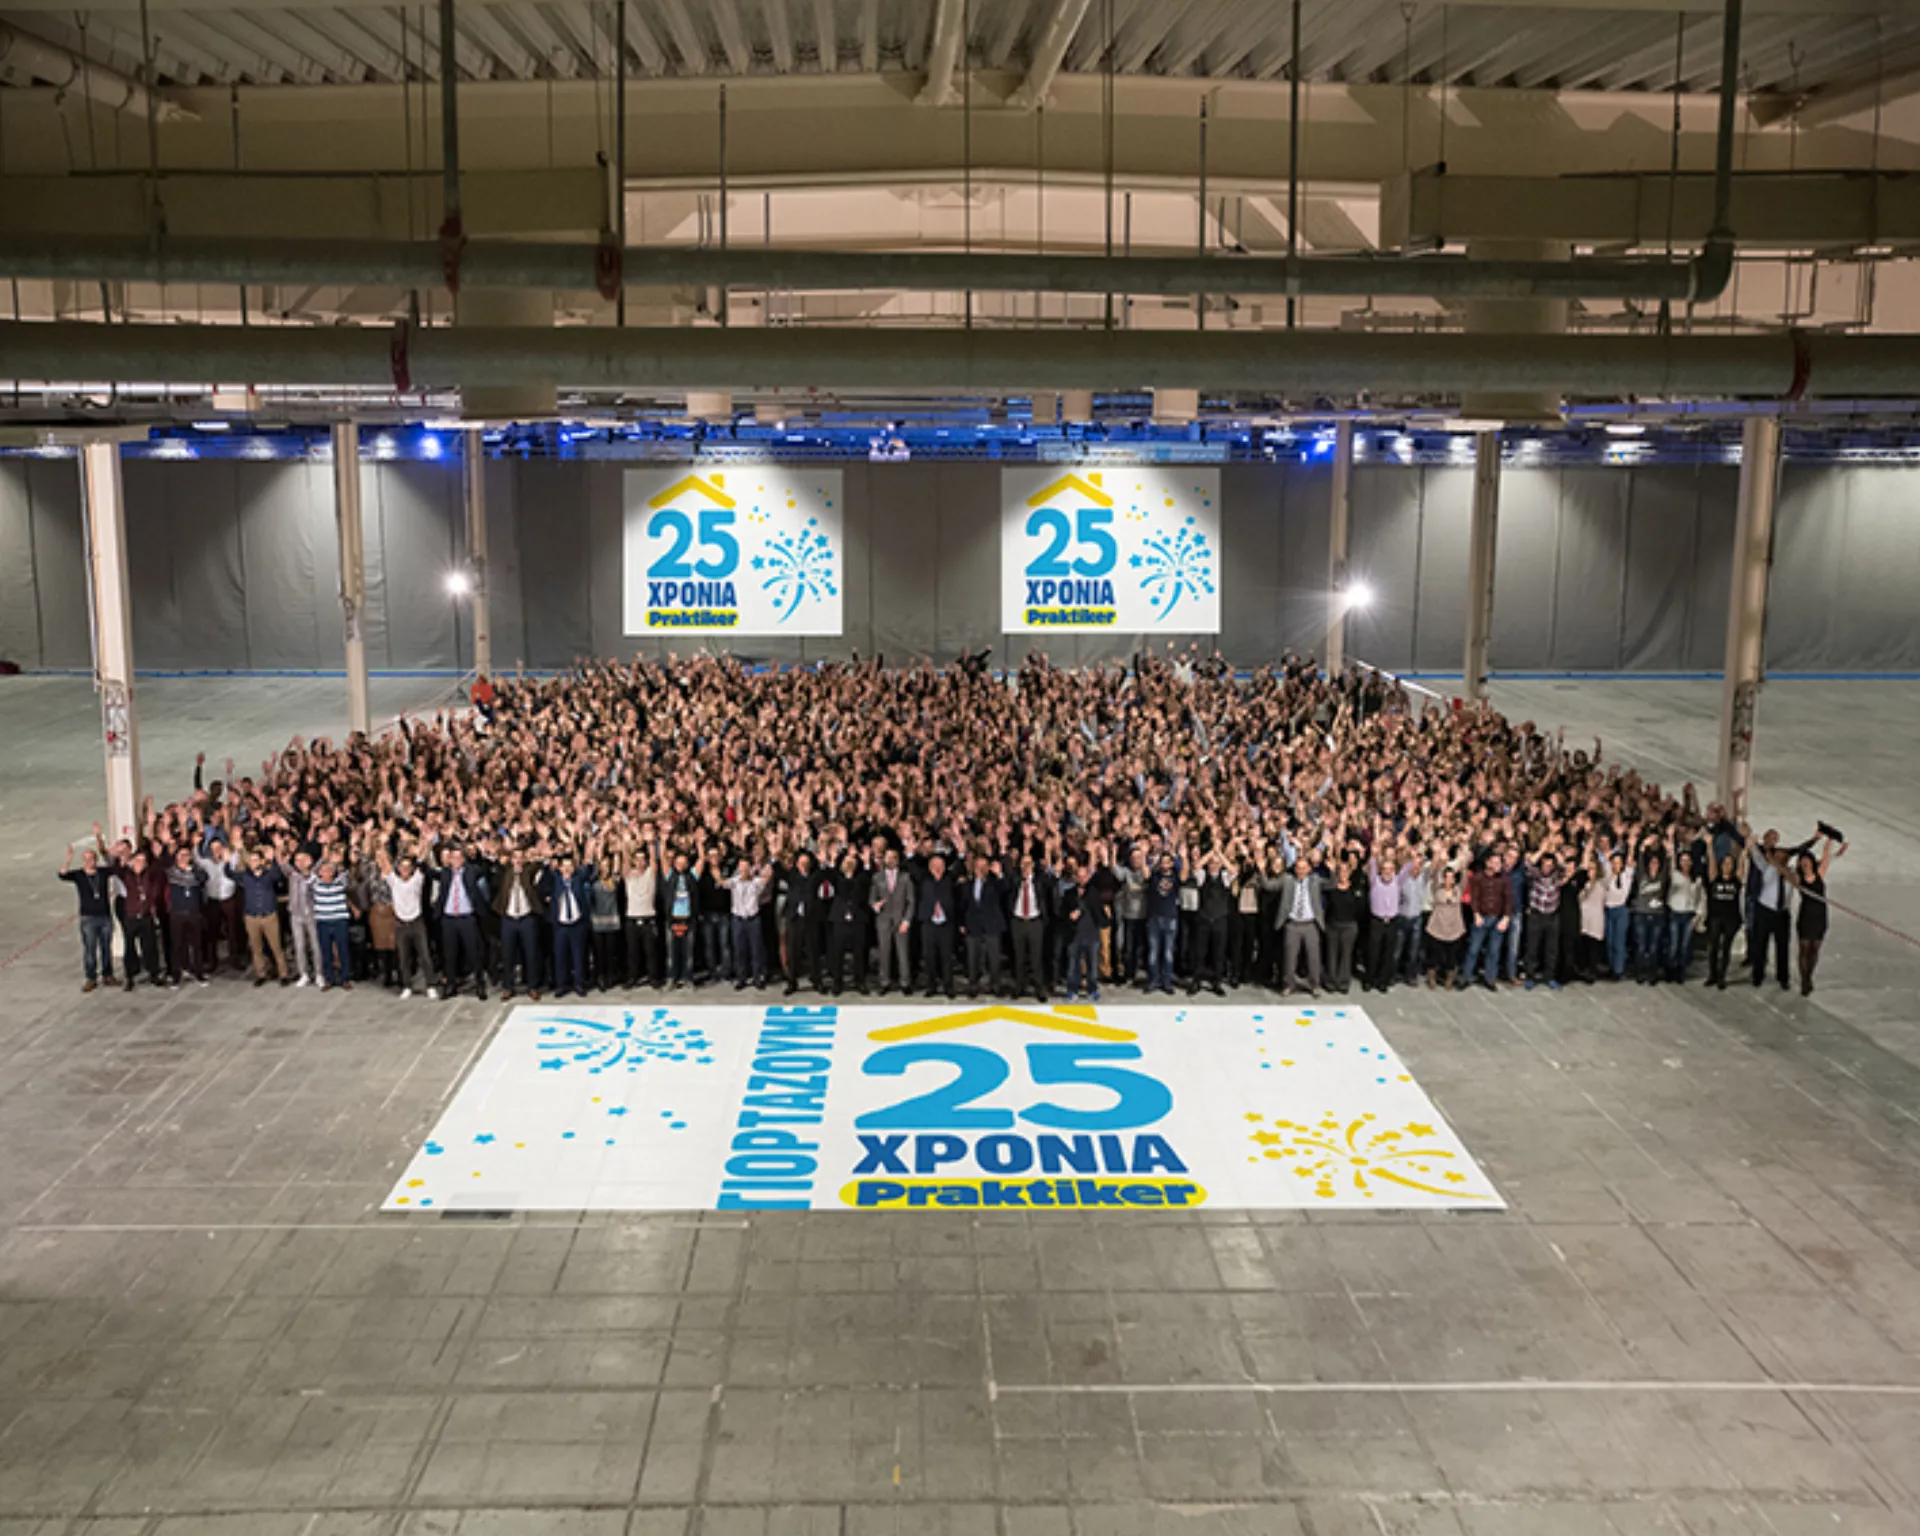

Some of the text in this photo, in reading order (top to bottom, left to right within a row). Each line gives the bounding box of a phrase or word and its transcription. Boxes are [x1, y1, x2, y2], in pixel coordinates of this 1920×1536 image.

[647, 510, 739, 579] 25
[1025, 509, 1117, 578] 25
[648, 581, 737, 607] ΧΡΟΝΙΑ
[1026, 579, 1115, 605] ΧΡΟΝΙΑ
[649, 611, 738, 627] Praktiker
[1028, 609, 1116, 625] Praktiker
[854, 1043, 1173, 1131] 25
[716, 1006, 838, 1210] ΓΙΟΡΤΑΖΟΥΜΕ
[852, 1135, 1188, 1174] ΧΡΟΝΙΑ
[856, 1179, 1196, 1207] Praktiker
